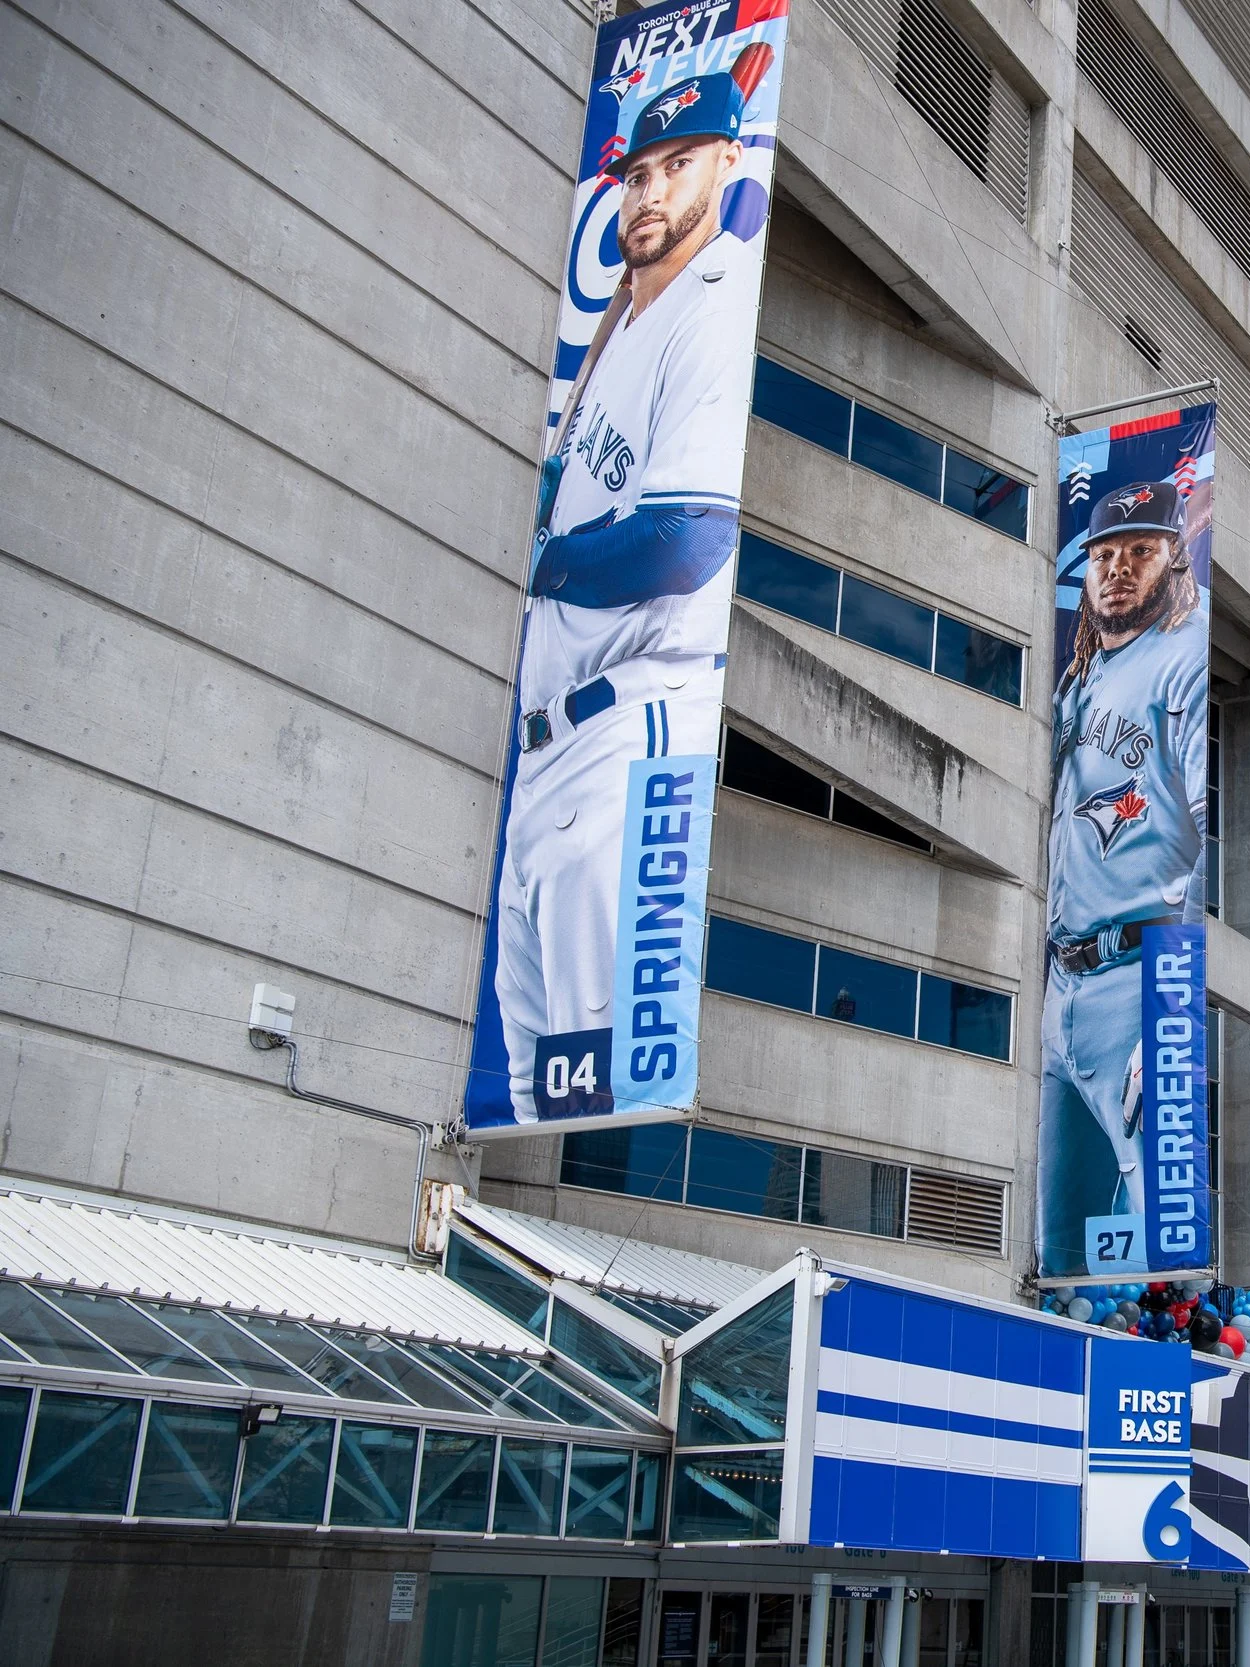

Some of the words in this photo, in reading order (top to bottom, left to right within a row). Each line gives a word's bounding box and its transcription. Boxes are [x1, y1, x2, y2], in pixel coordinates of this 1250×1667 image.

[610, 2, 731, 77] NEXT
[638, 11, 681, 32] TORONTO
[690, 0, 712, 14] BLUE
[577, 402, 635, 492] JAYS
[1076, 707, 1154, 770] JAYS
[630, 770, 695, 1083] SPRINGER
[1156, 941, 1192, 1006] JR.
[546, 1052, 597, 1099] 04
[1156, 1016, 1196, 1254] GUERRERO
[1097, 1230, 1134, 1261] 27
[1118, 1389, 1186, 1415] FIRST
[1120, 1418, 1182, 1444] BASE
[1143, 1480, 1191, 1561] 6
